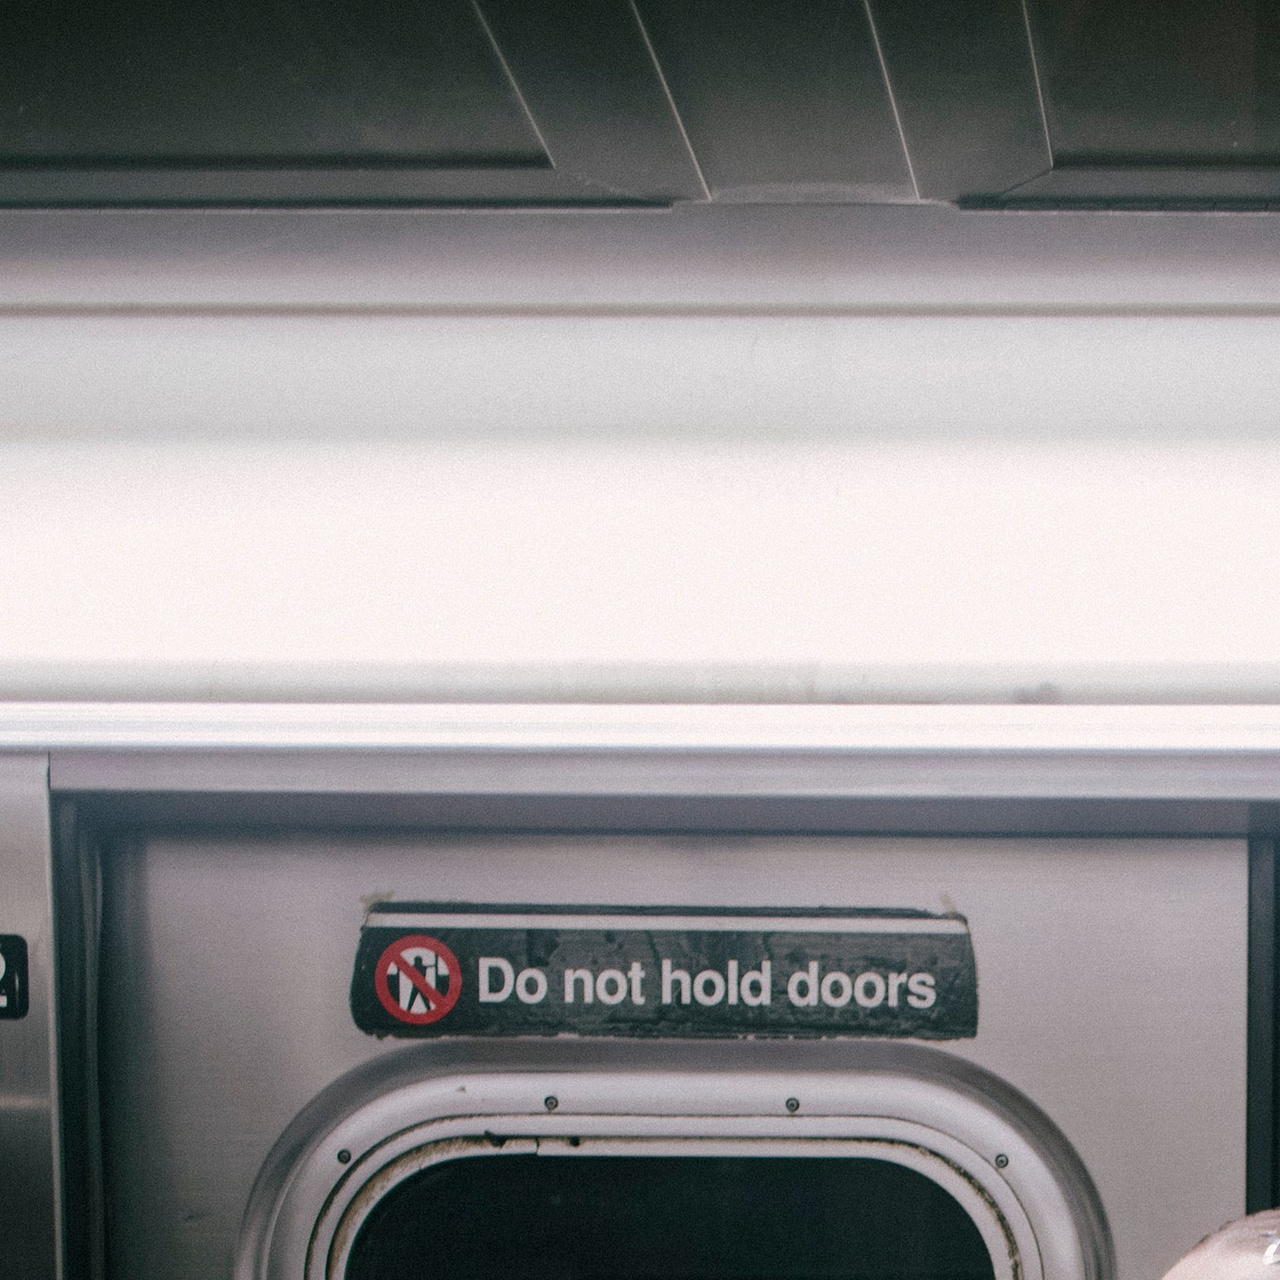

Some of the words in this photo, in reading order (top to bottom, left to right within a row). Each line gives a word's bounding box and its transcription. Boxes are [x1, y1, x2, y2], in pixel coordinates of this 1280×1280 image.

[478, 957, 548, 1004] Do
[564, 961, 646, 1006] not
[661, 958, 772, 1007] hold
[787, 960, 938, 1009] doors
